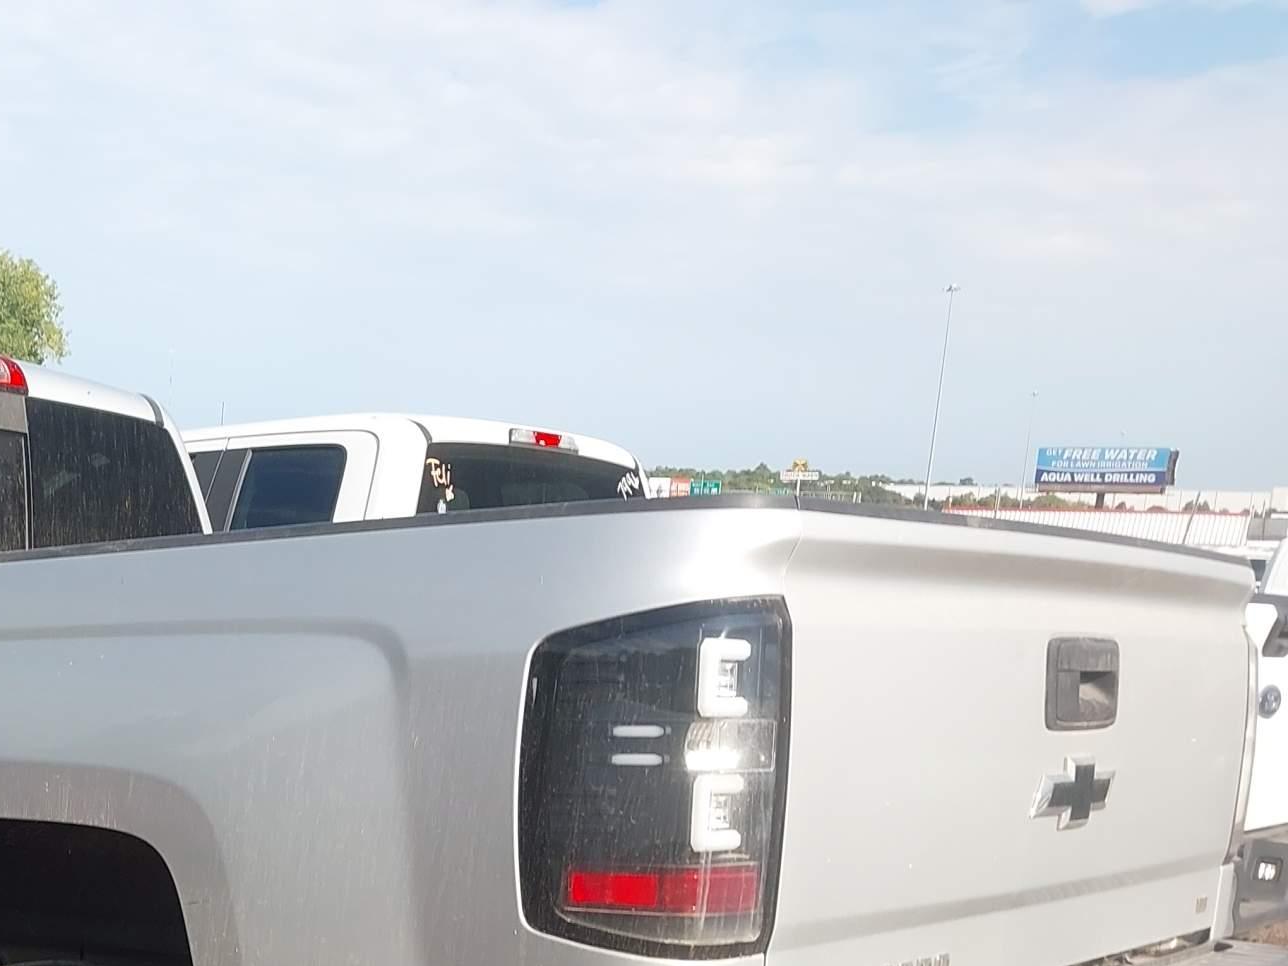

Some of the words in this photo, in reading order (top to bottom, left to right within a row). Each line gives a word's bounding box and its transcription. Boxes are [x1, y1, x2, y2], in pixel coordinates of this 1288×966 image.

[1063, 448, 1102, 460] FREE
[1104, 448, 1158, 461] WATER
[1070, 460, 1096, 468] LAWN
[1097, 460, 1149, 469] IRRIGATION
[1040, 471, 1072, 482] AQUA
[1073, 472, 1103, 482] WELL
[1104, 472, 1157, 483] DRILLING
